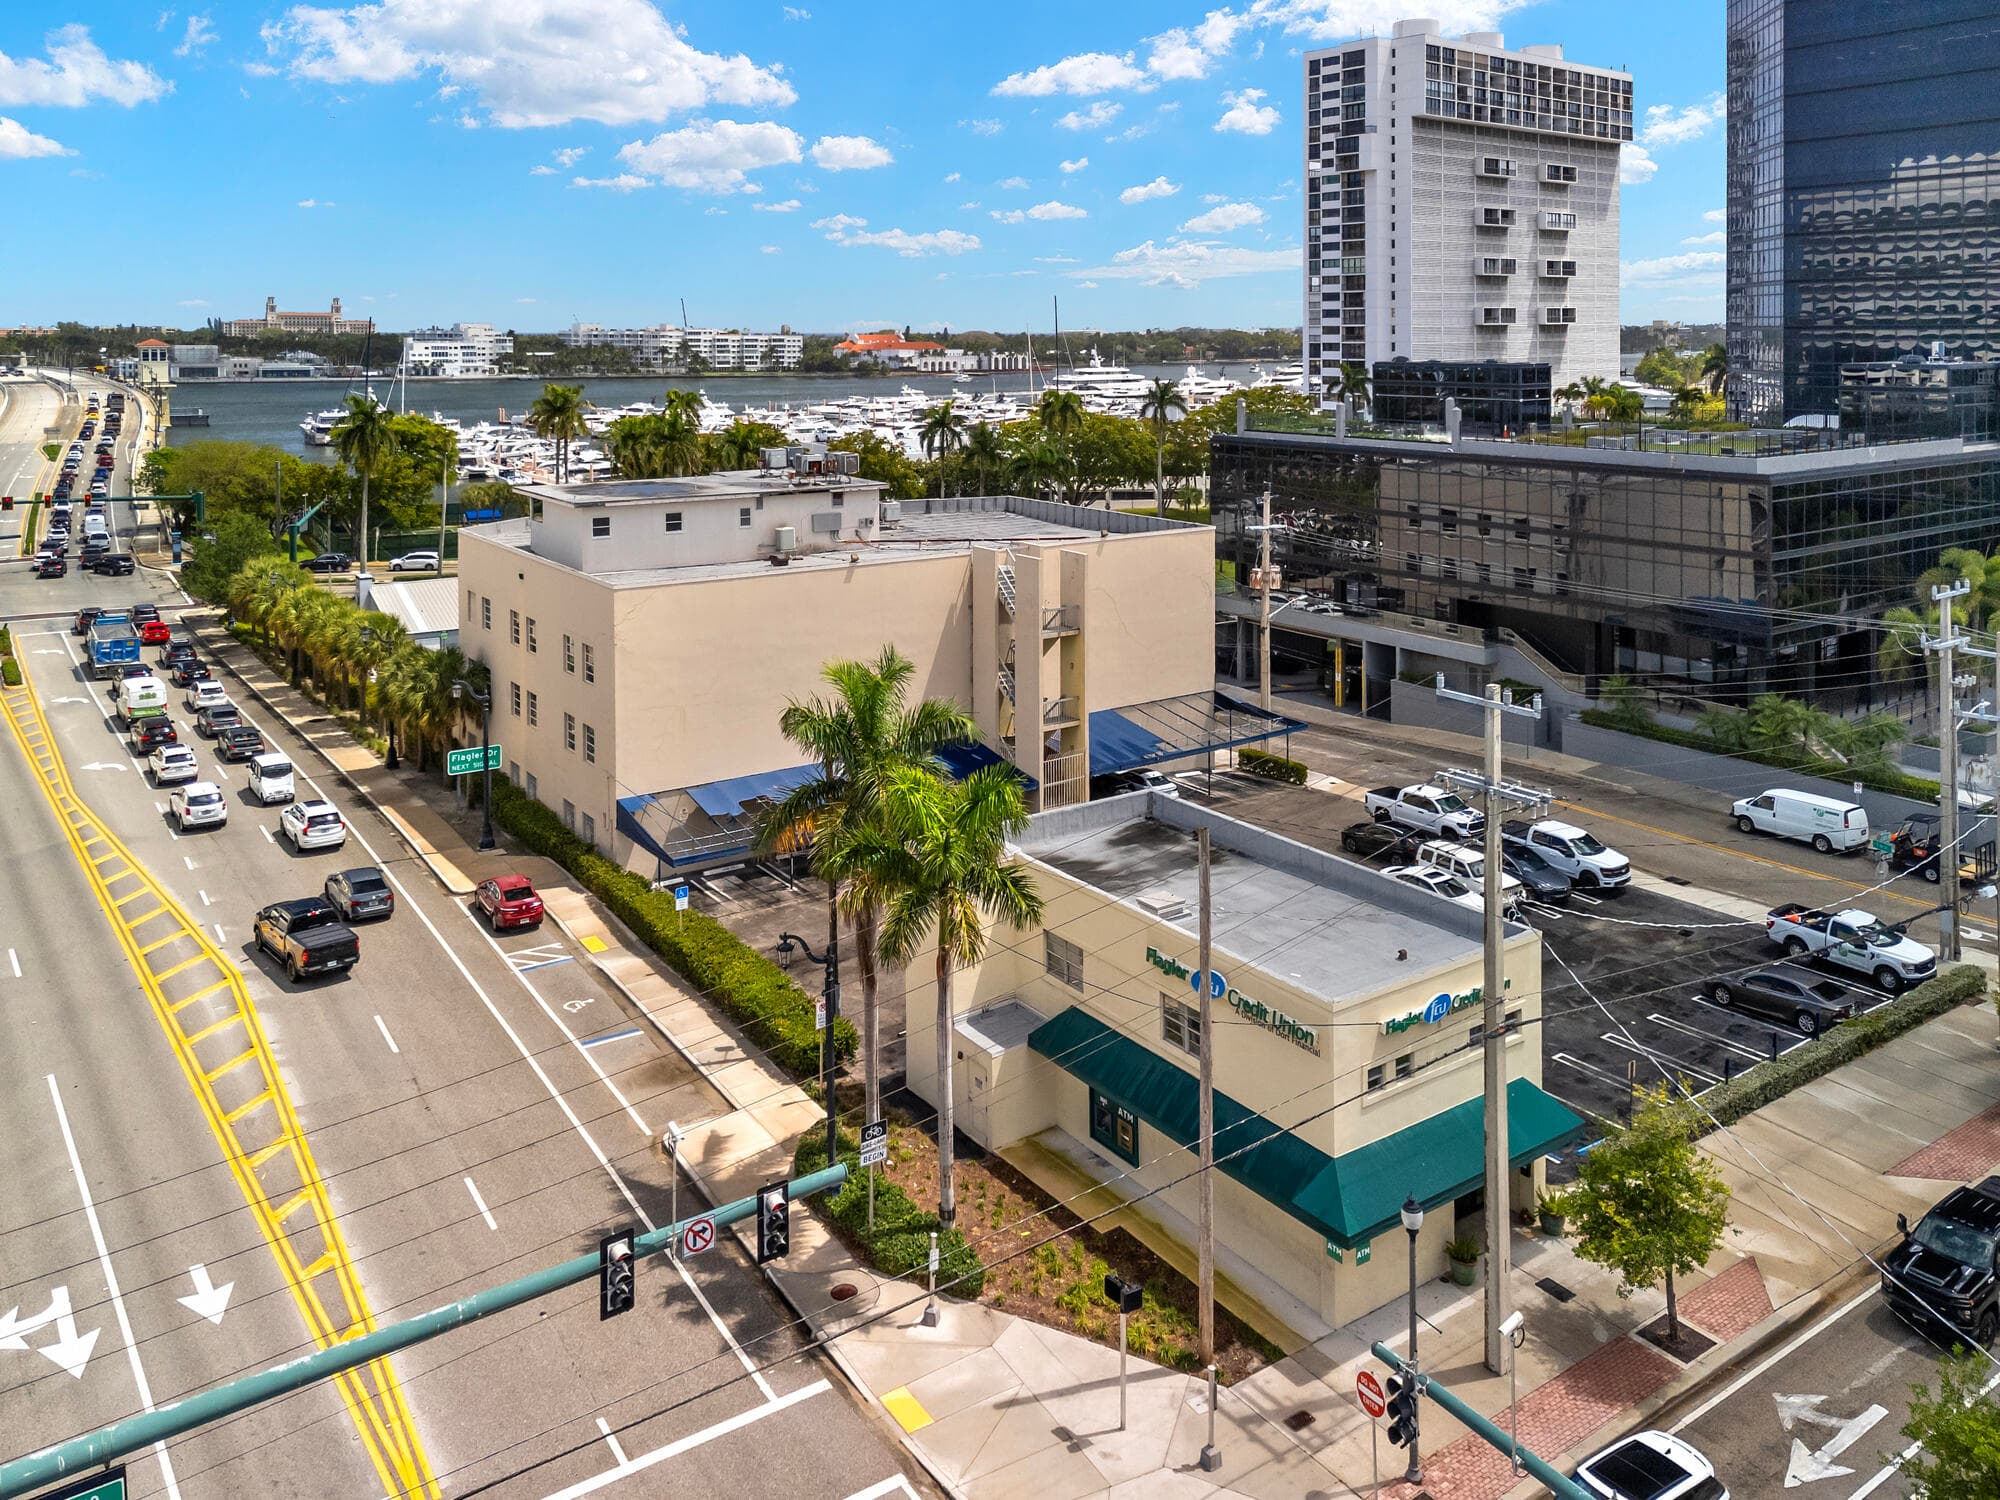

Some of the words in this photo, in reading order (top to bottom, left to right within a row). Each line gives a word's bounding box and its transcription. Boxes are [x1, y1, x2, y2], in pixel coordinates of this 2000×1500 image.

[451, 752, 484, 762] Flagler
[487, 749, 498, 757] Dr
[451, 763, 470, 771] NEXT
[472, 759, 497, 769] SIGAL
[1146, 945, 1190, 981] Flagler
[1227, 988, 1270, 1024] Credit
[1272, 1009, 1316, 1047] Union
[1385, 1010, 1424, 1036] Flagler
[1451, 988, 1482, 1009] Credit
[1117, 1106, 1134, 1124] ATM
[863, 1150, 885, 1164] BEGIN
[1327, 1242, 1342, 1257] ATM
[1356, 1247, 1370, 1260] ATM
[1360, 1375, 1369, 1386] DO
[1368, 1381, 1380, 1396] NOT
[1362, 1394, 1380, 1412] ENTER
